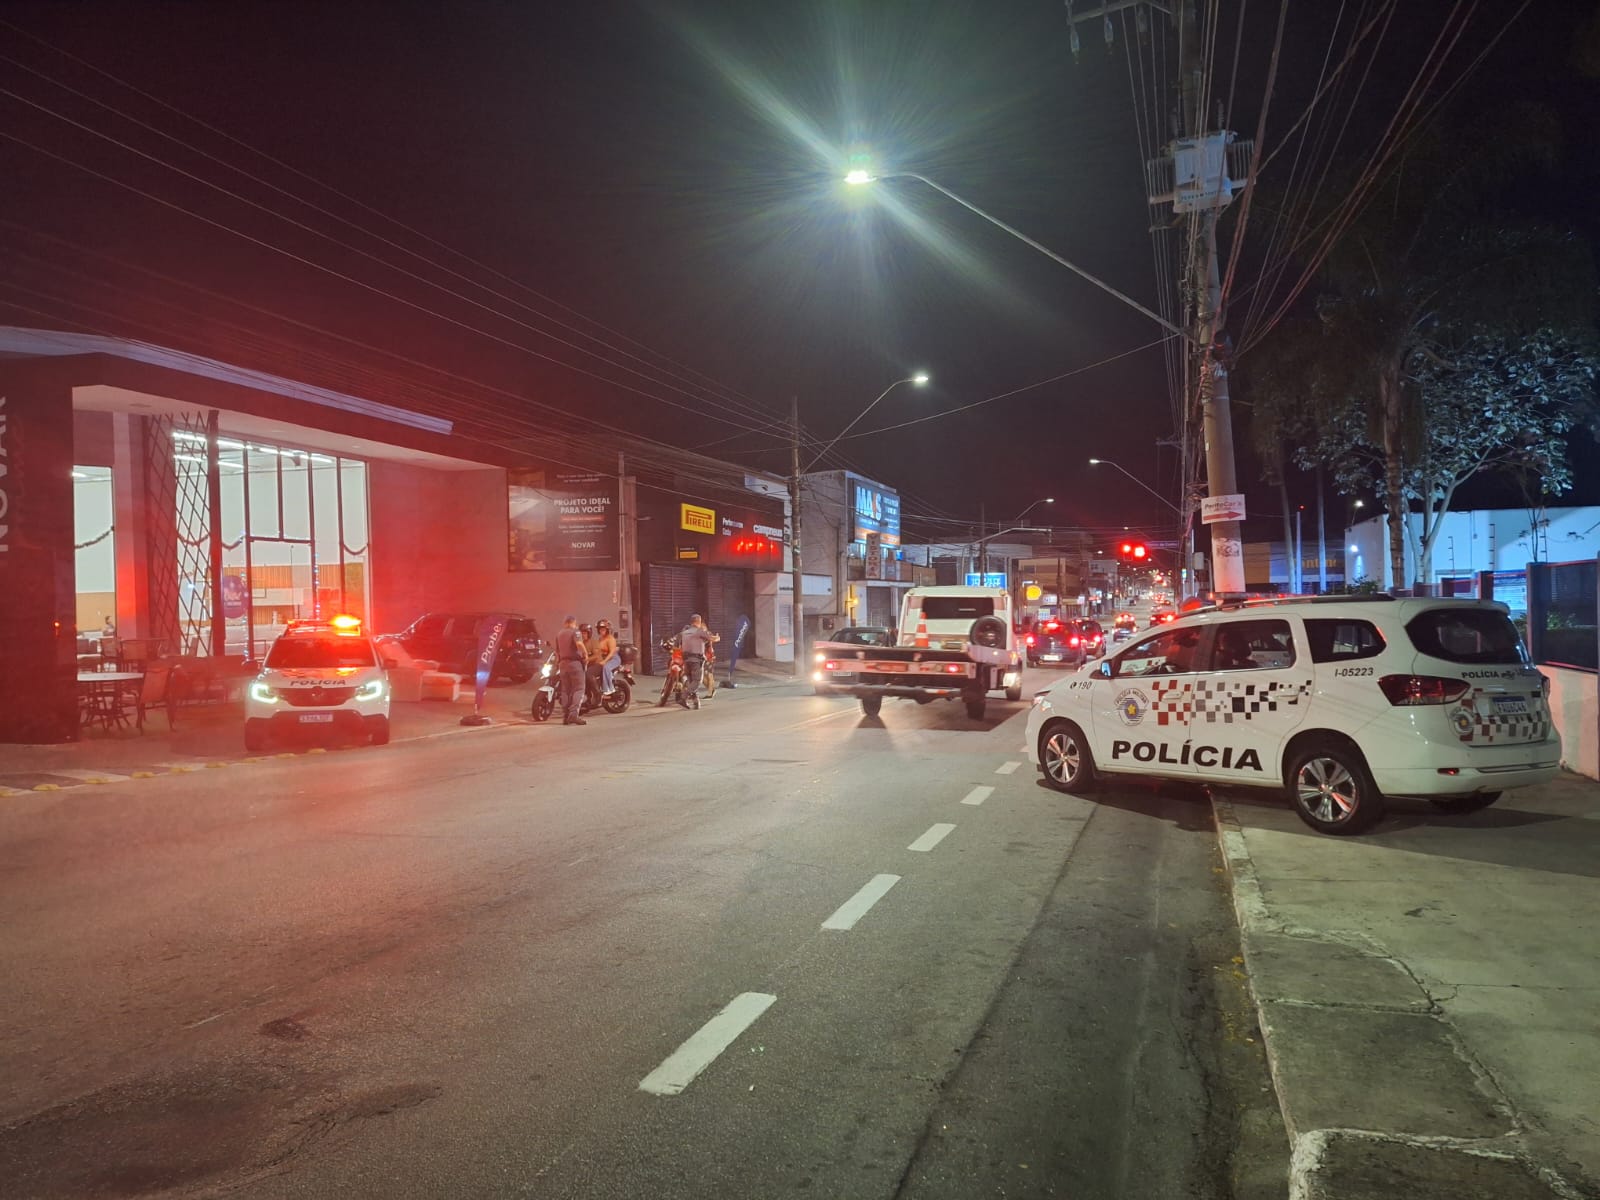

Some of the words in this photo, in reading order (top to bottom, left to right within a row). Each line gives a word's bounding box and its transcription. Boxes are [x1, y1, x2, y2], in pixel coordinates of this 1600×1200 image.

[554, 498, 587, 506] PROJETO
[589, 497, 611, 505] IDEAL
[560, 506, 580, 514] PARA
[685, 509, 713, 529] PIRELLI
[571, 541, 596, 549] NOVAR
[1334, 666, 1374, 677] I-05223
[1078, 681, 1093, 690] 190
[1111, 739, 1264, 772] POLÍCIA
